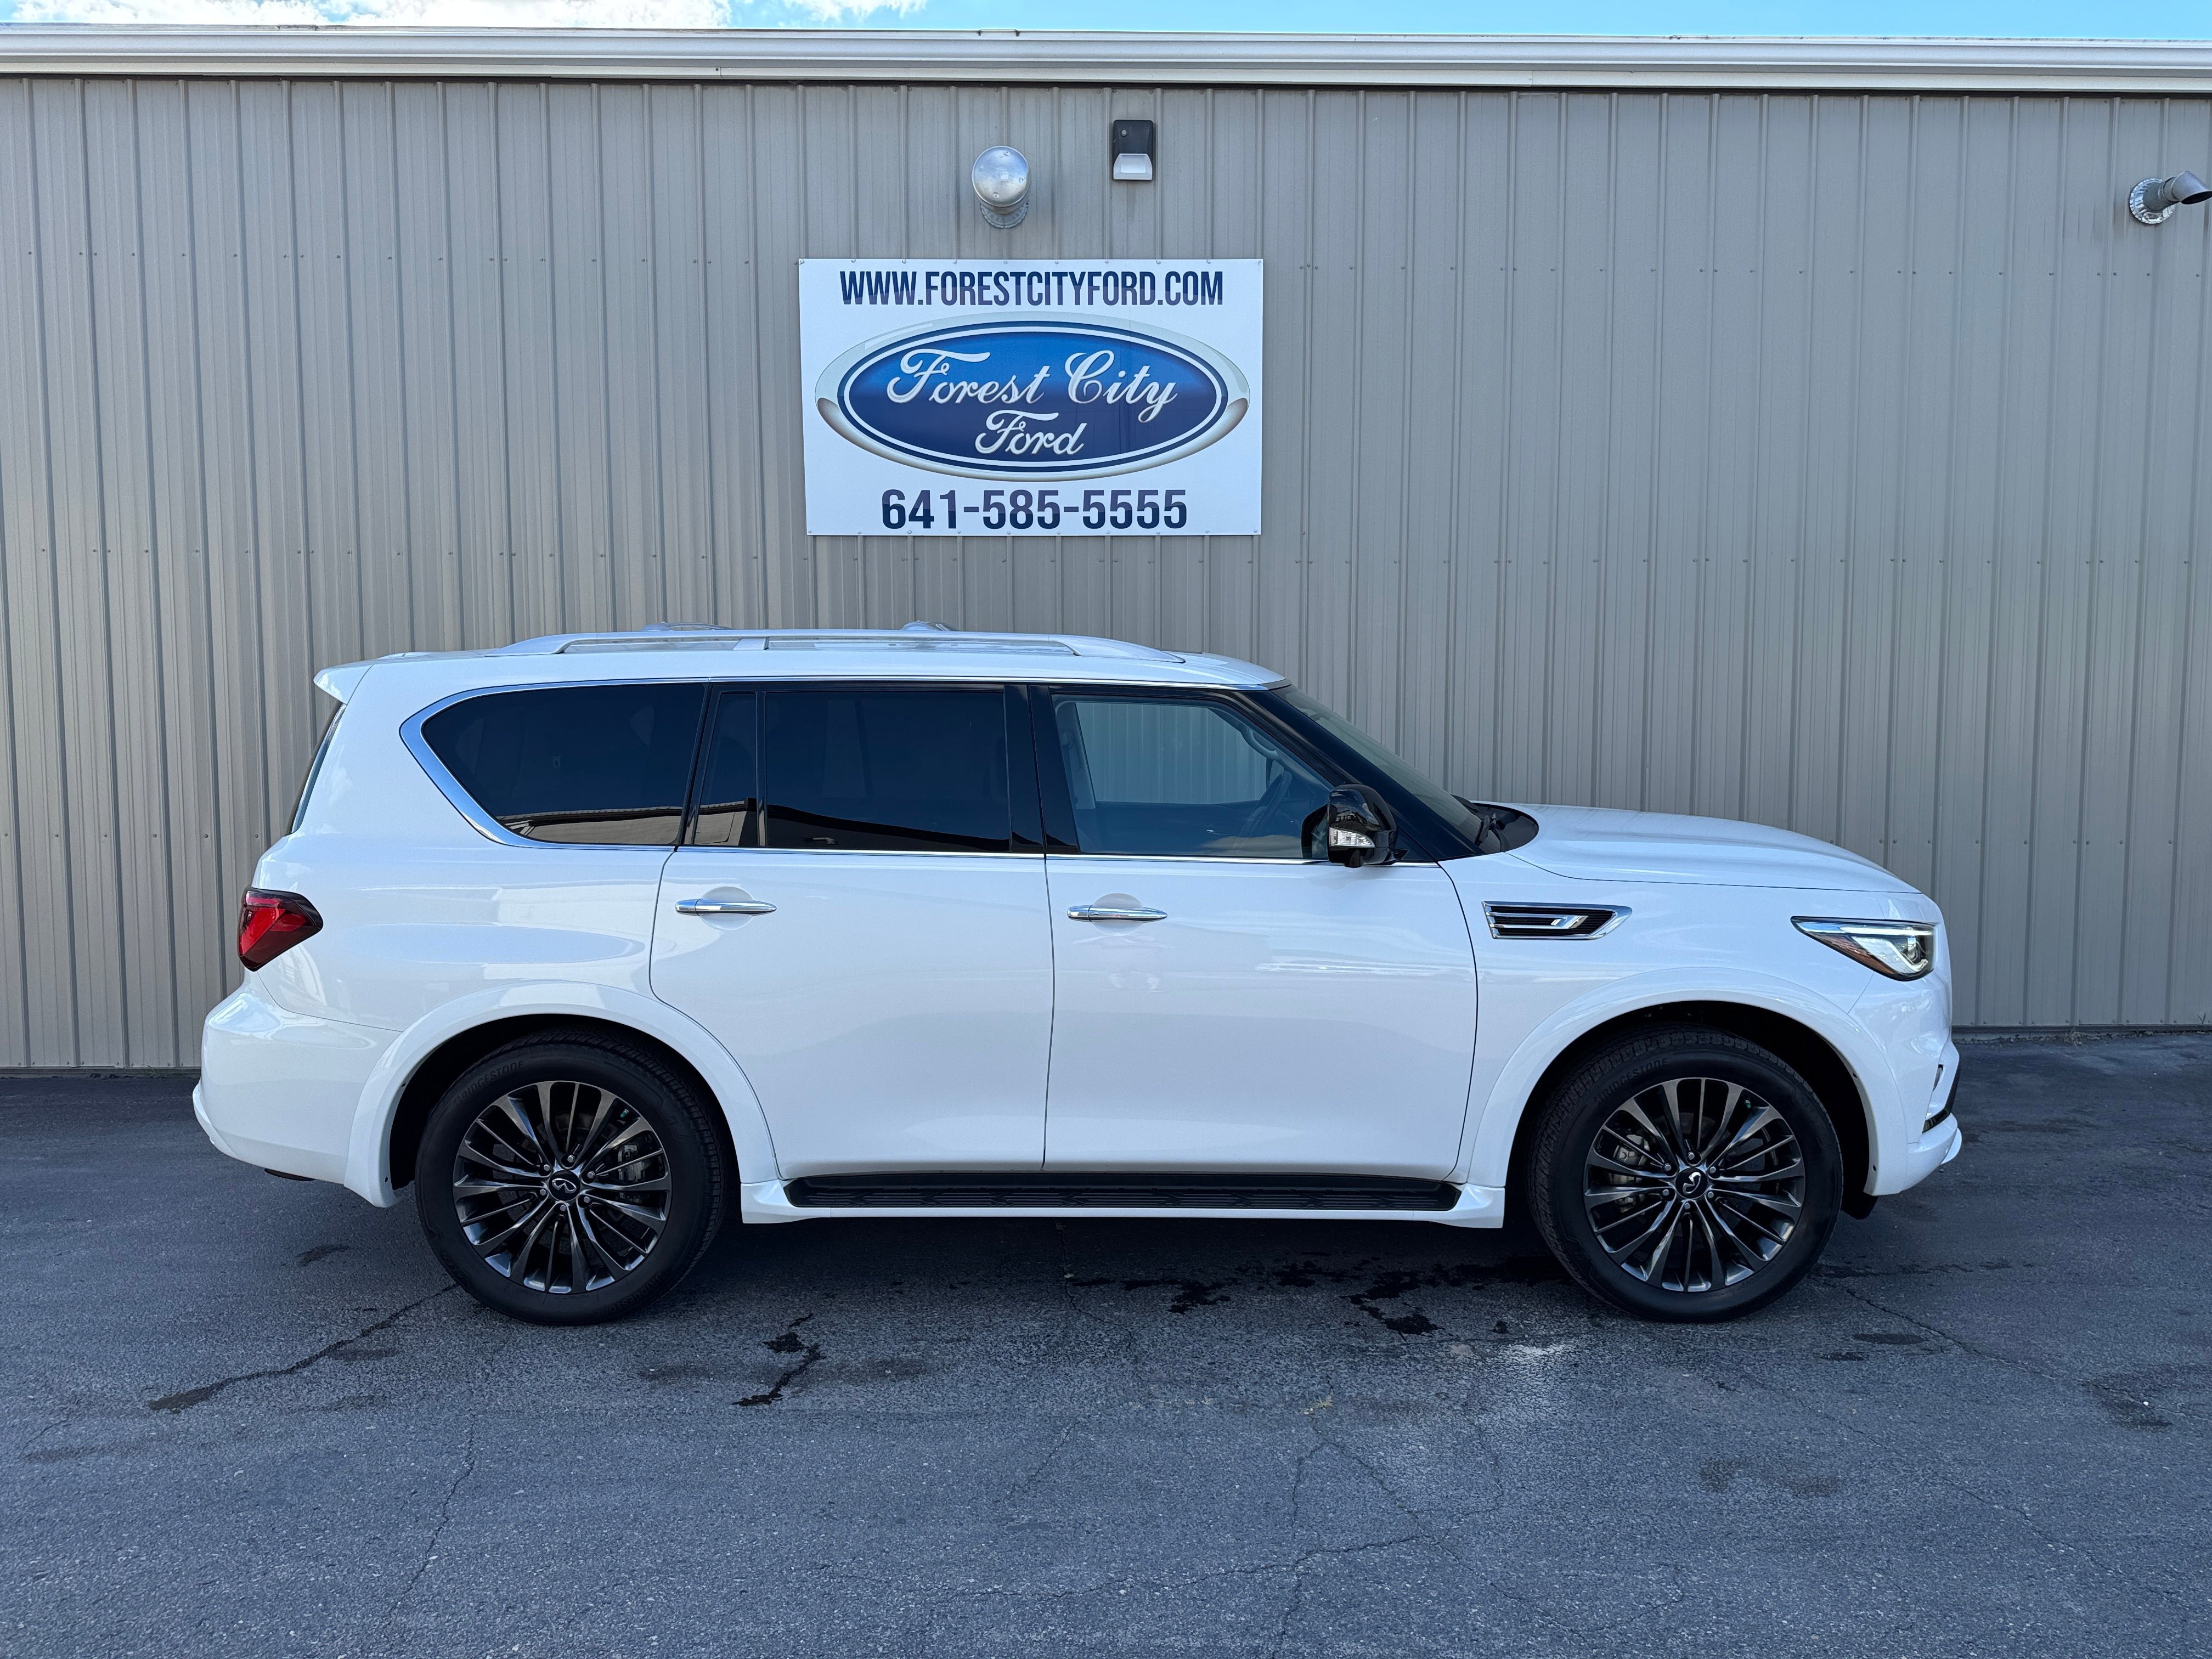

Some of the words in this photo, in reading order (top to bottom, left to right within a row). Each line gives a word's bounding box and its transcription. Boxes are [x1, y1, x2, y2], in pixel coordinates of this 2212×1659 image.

[840, 271, 1223, 306] WWW.FORESTCITYFORD.COM
[887, 348, 1051, 404] Forest
[1064, 350, 1178, 423] City
[975, 409, 1087, 455] Ford
[882, 489, 1187, 529] 641-585-5555
